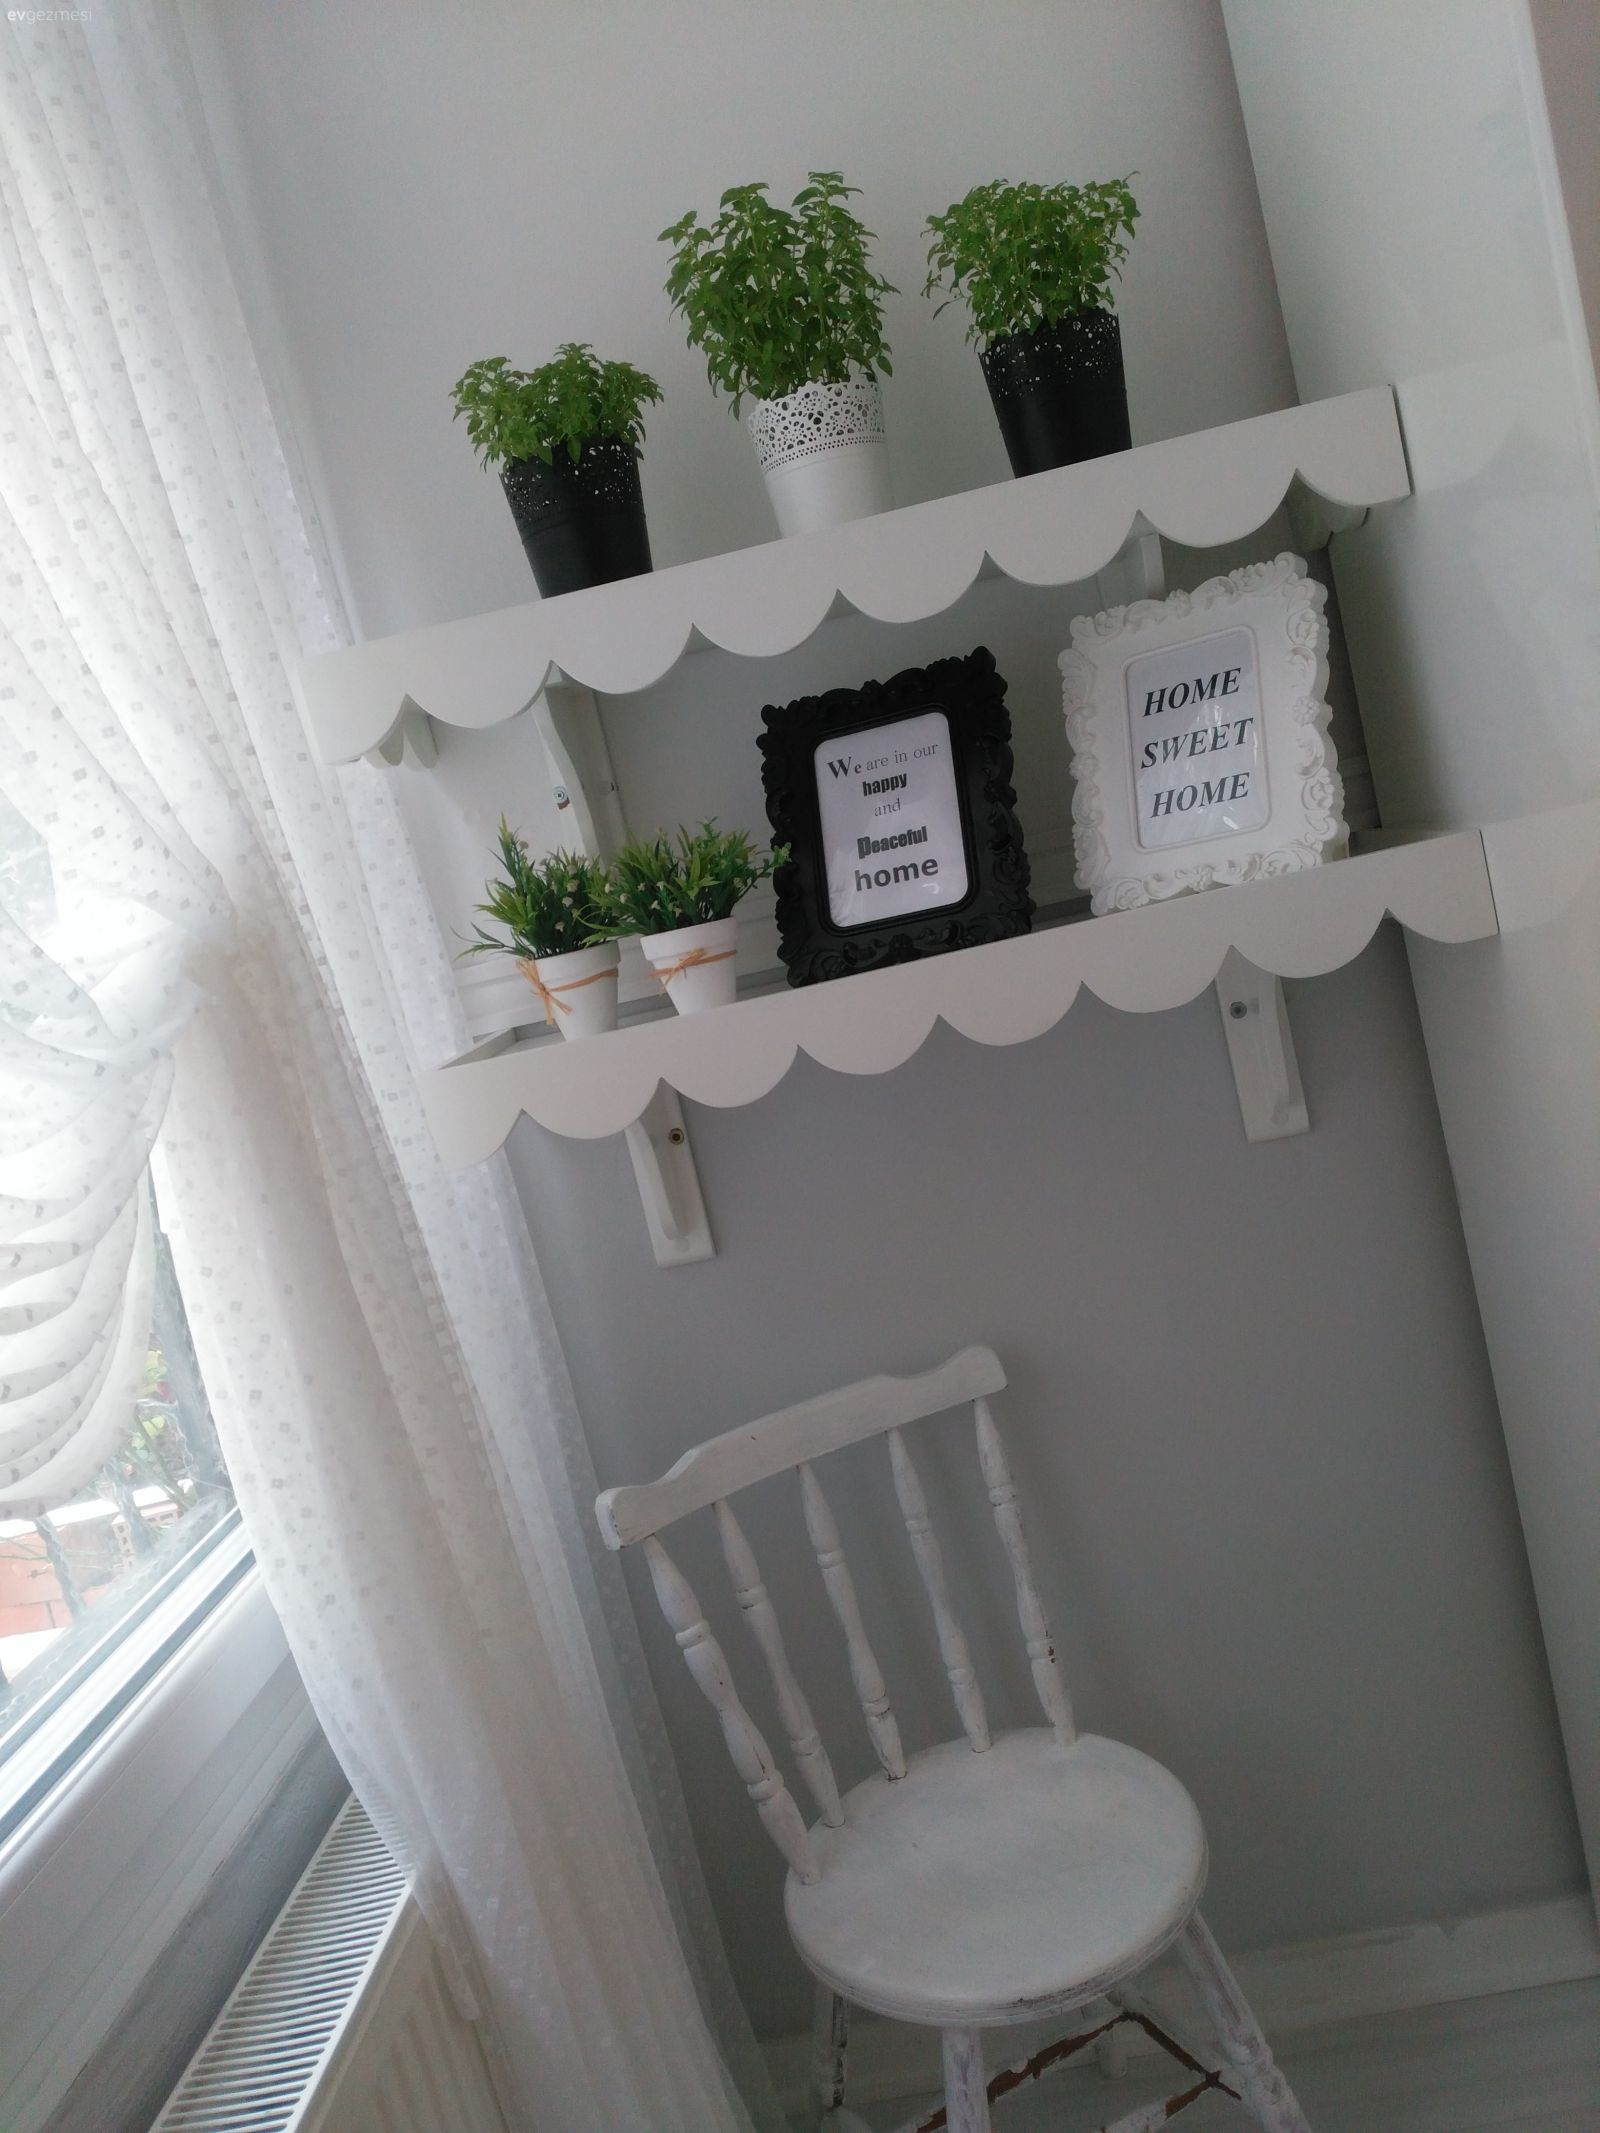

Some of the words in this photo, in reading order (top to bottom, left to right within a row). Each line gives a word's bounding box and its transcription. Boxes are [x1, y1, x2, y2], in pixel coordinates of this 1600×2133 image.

[1142, 667, 1242, 717] HOME
[827, 756, 862, 779] We
[866, 757, 889, 772] are
[894, 749, 908, 764] in
[913, 743, 939, 759] our
[1141, 718, 1254, 769] SWEET
[862, 773, 908, 796] happy
[1150, 772, 1250, 818] HOME
[874, 798, 902, 817] and
[854, 857, 939, 891] home
